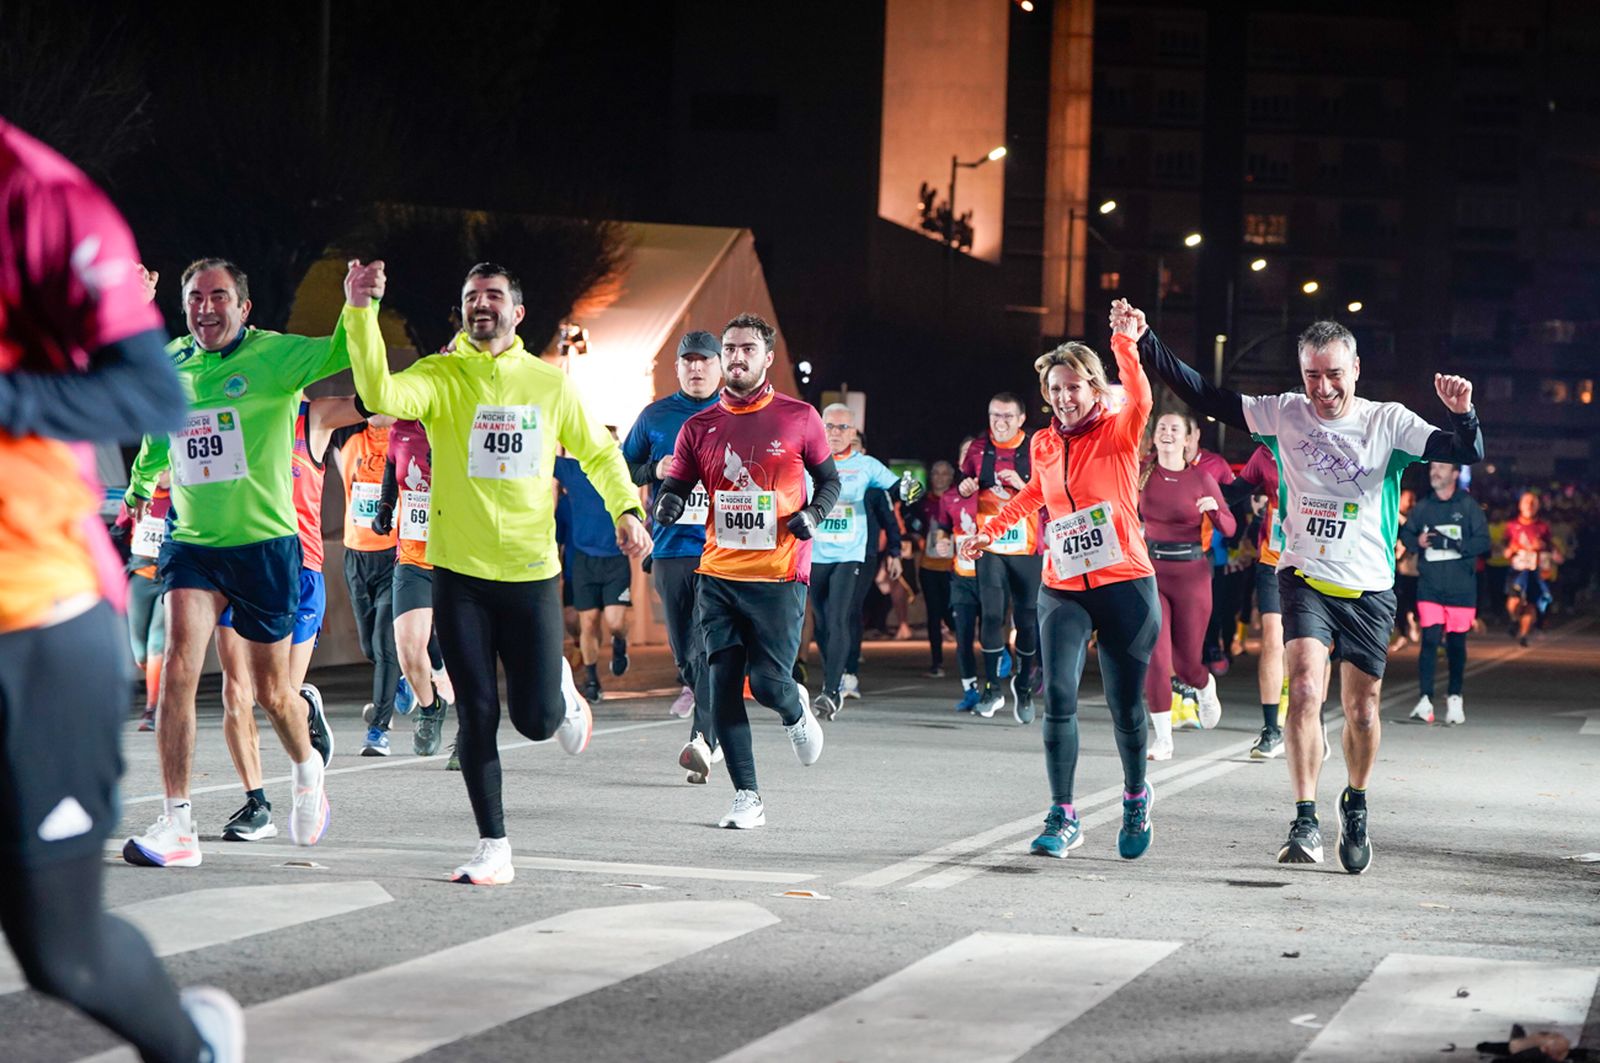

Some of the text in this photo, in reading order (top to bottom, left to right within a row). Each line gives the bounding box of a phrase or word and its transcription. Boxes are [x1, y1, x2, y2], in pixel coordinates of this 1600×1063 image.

[482, 413, 505, 421] NOCHE
[187, 435, 223, 459] 639
[483, 432, 523, 453] 498
[1301, 507, 1313, 515] SAN
[1309, 500, 1328, 509] NOCHE
[725, 512, 765, 529] 6404
[1078, 517, 1086, 525] DE
[1306, 517, 1347, 539] 4757
[1063, 528, 1104, 555] 4759
